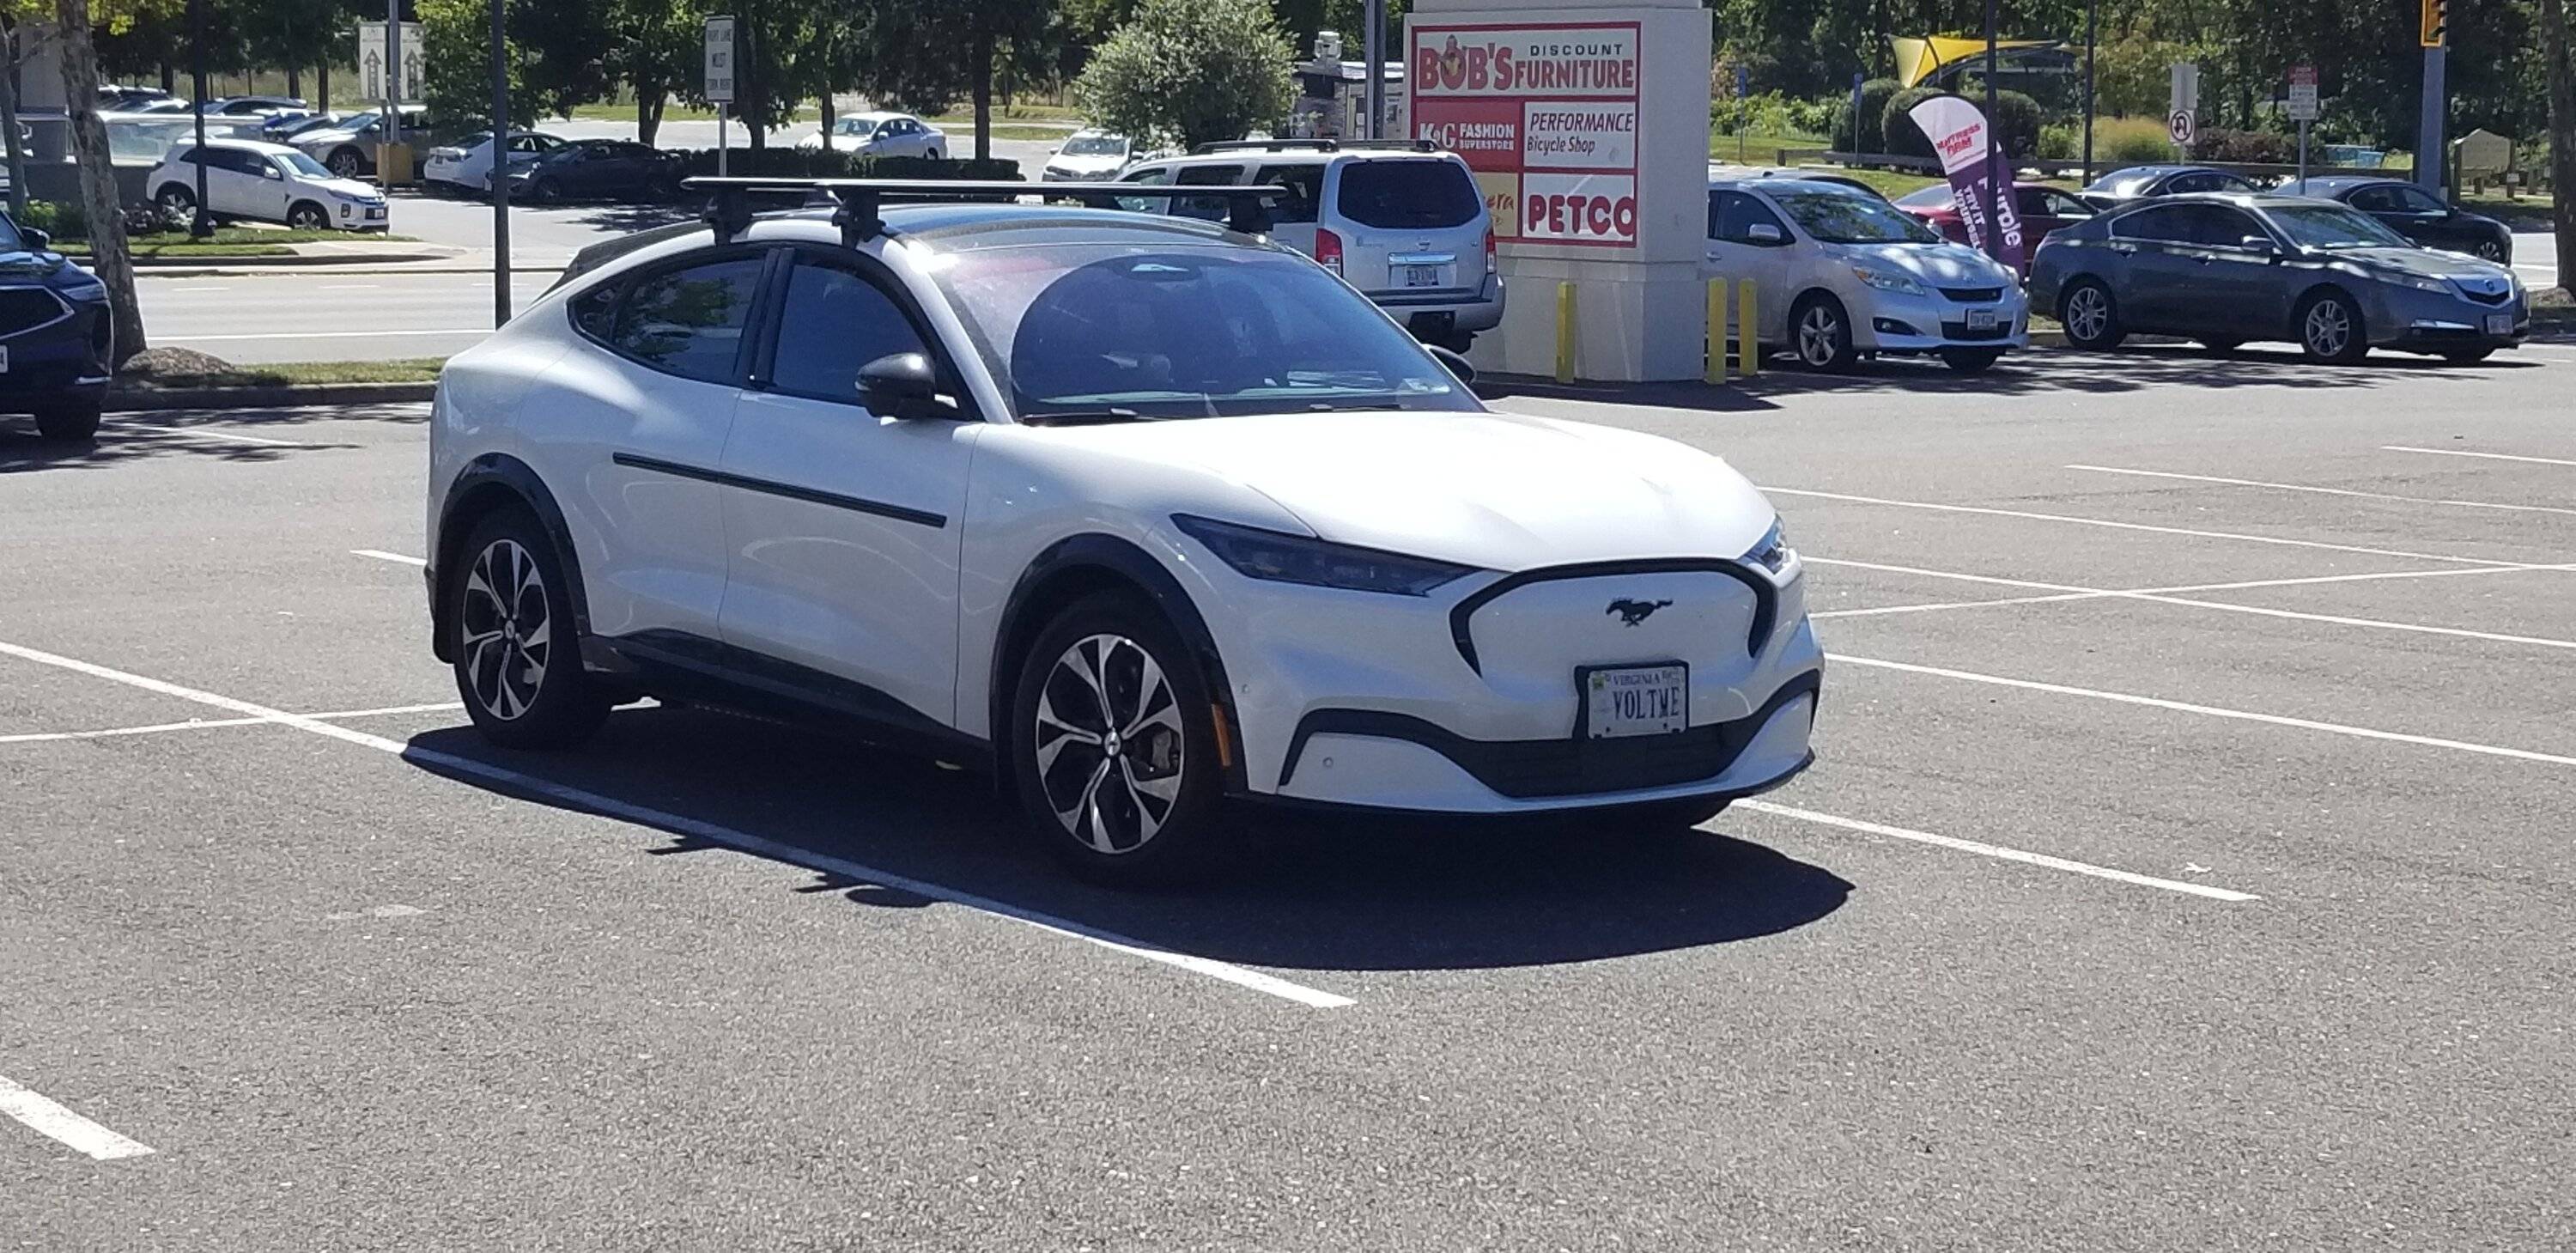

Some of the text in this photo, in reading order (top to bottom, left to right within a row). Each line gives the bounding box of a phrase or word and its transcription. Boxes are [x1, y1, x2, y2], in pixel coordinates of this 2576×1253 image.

[1530, 44, 1623, 57] DISCOUNT
[1419, 42, 1513, 91] BOB'S
[1515, 59, 1635, 89] FURNITURE
[1460, 123, 1515, 139] FASHION
[1529, 113, 1634, 132] PERFORMANCE
[1460, 138, 1515, 151] SUPERSTORE
[1527, 136, 1595, 156] Bicycle Shop
[1964, 185, 1981, 210] TRY
[1528, 194, 1636, 236] PETCO
